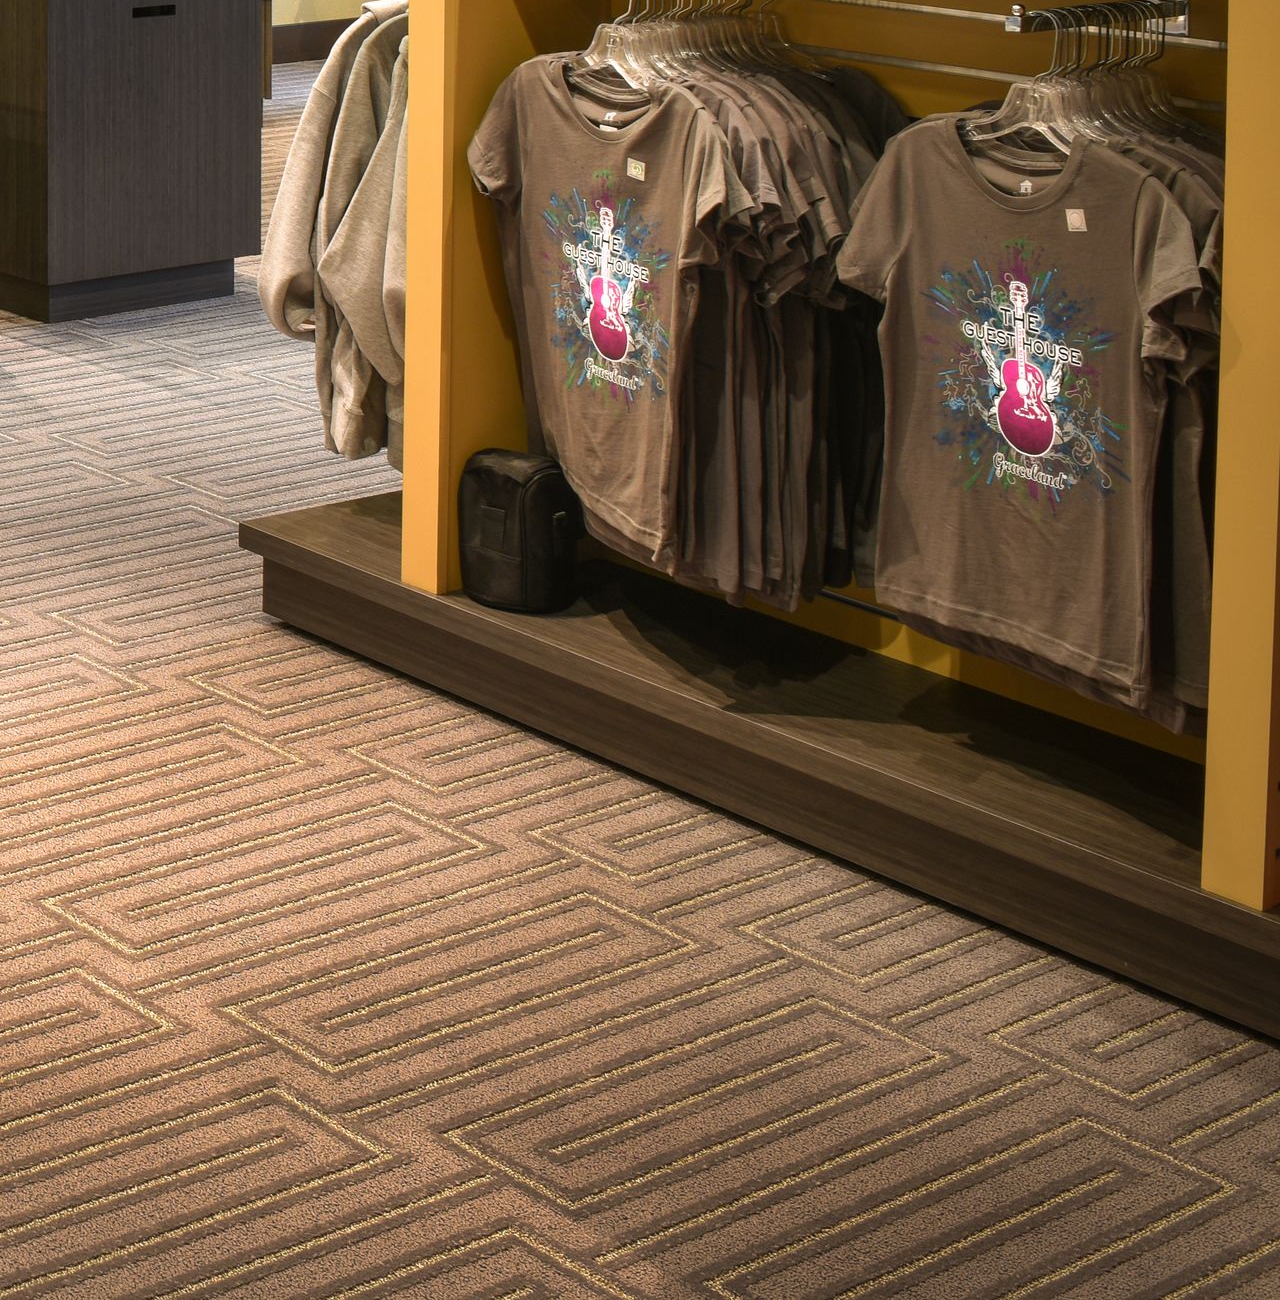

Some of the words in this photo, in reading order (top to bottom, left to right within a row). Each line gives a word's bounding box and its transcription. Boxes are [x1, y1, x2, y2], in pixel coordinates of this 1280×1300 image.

[590, 231, 622, 254] THE
[563, 242, 602, 268] GUEST
[607, 257, 650, 283] HOUSE
[999, 307, 1040, 334] THE
[962, 320, 1015, 347] GUEST
[1023, 338, 1083, 367] HOUSE
[584, 357, 638, 390] Graceland
[993, 452, 1066, 490] Graceland
